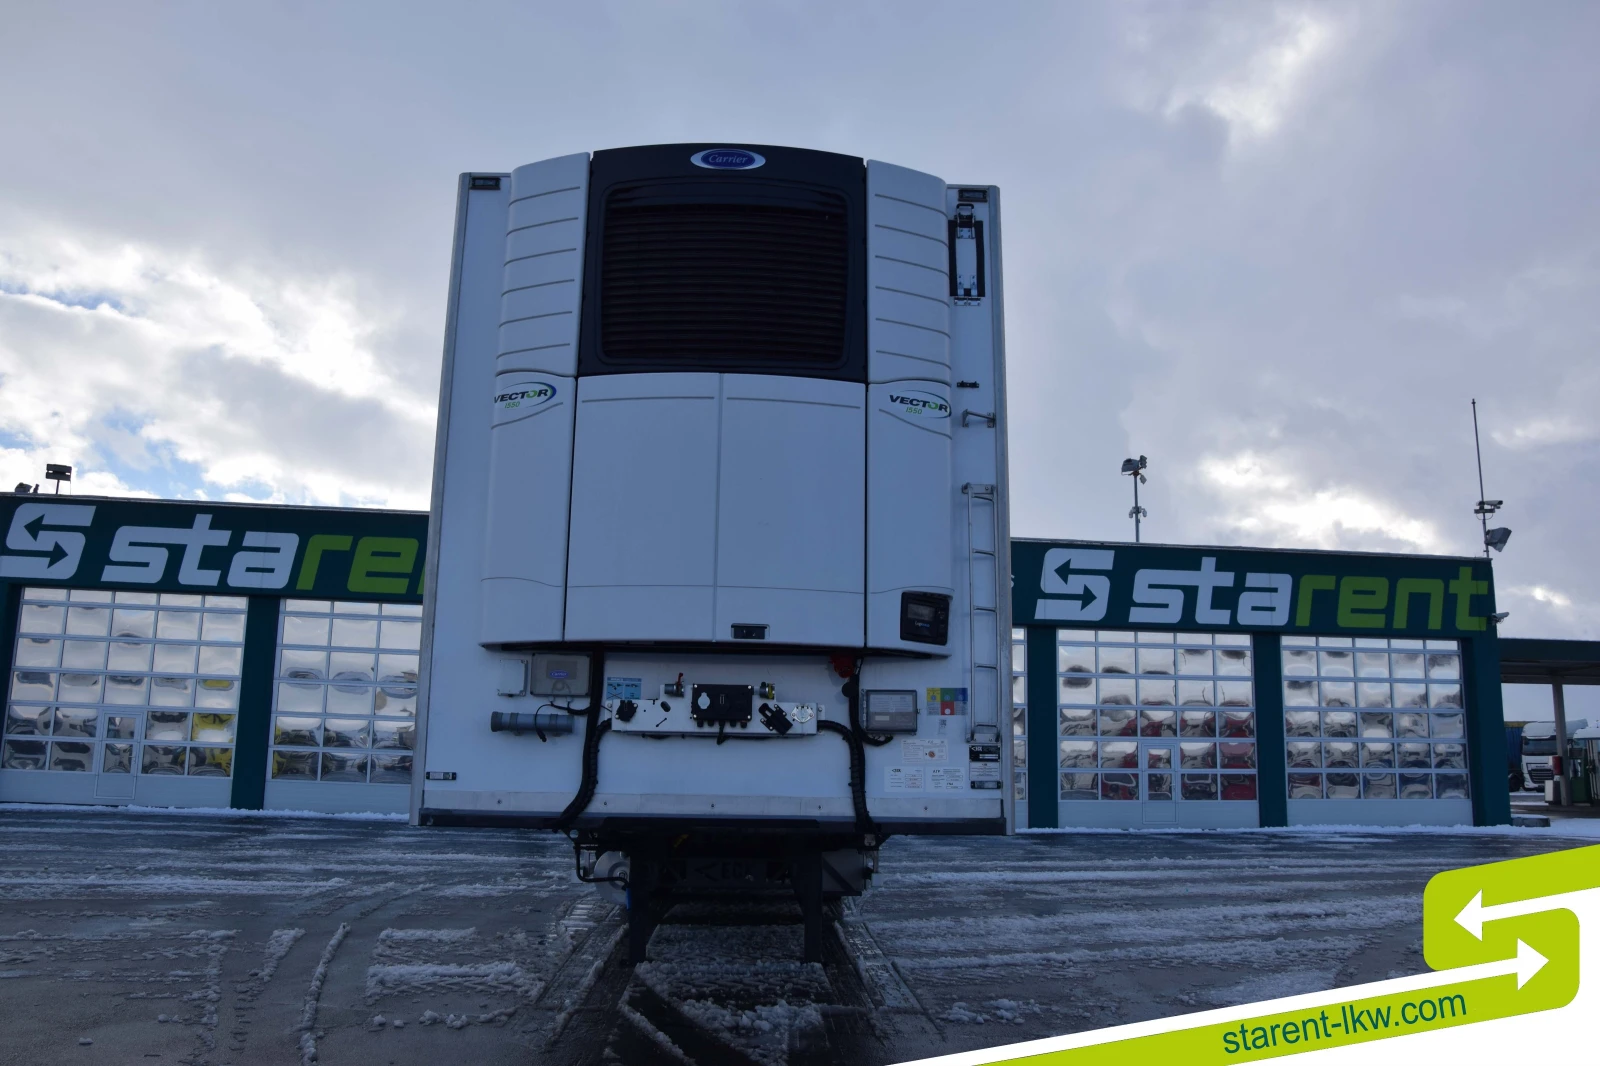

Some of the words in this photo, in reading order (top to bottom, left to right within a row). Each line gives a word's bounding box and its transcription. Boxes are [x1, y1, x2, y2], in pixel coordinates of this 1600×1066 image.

[708, 154, 748, 164] Carrier
[494, 388, 549, 403] VECTOR
[889, 394, 949, 413] VECTOR
[100, 513, 426, 595] stare
[1128, 556, 1489, 632] starent
